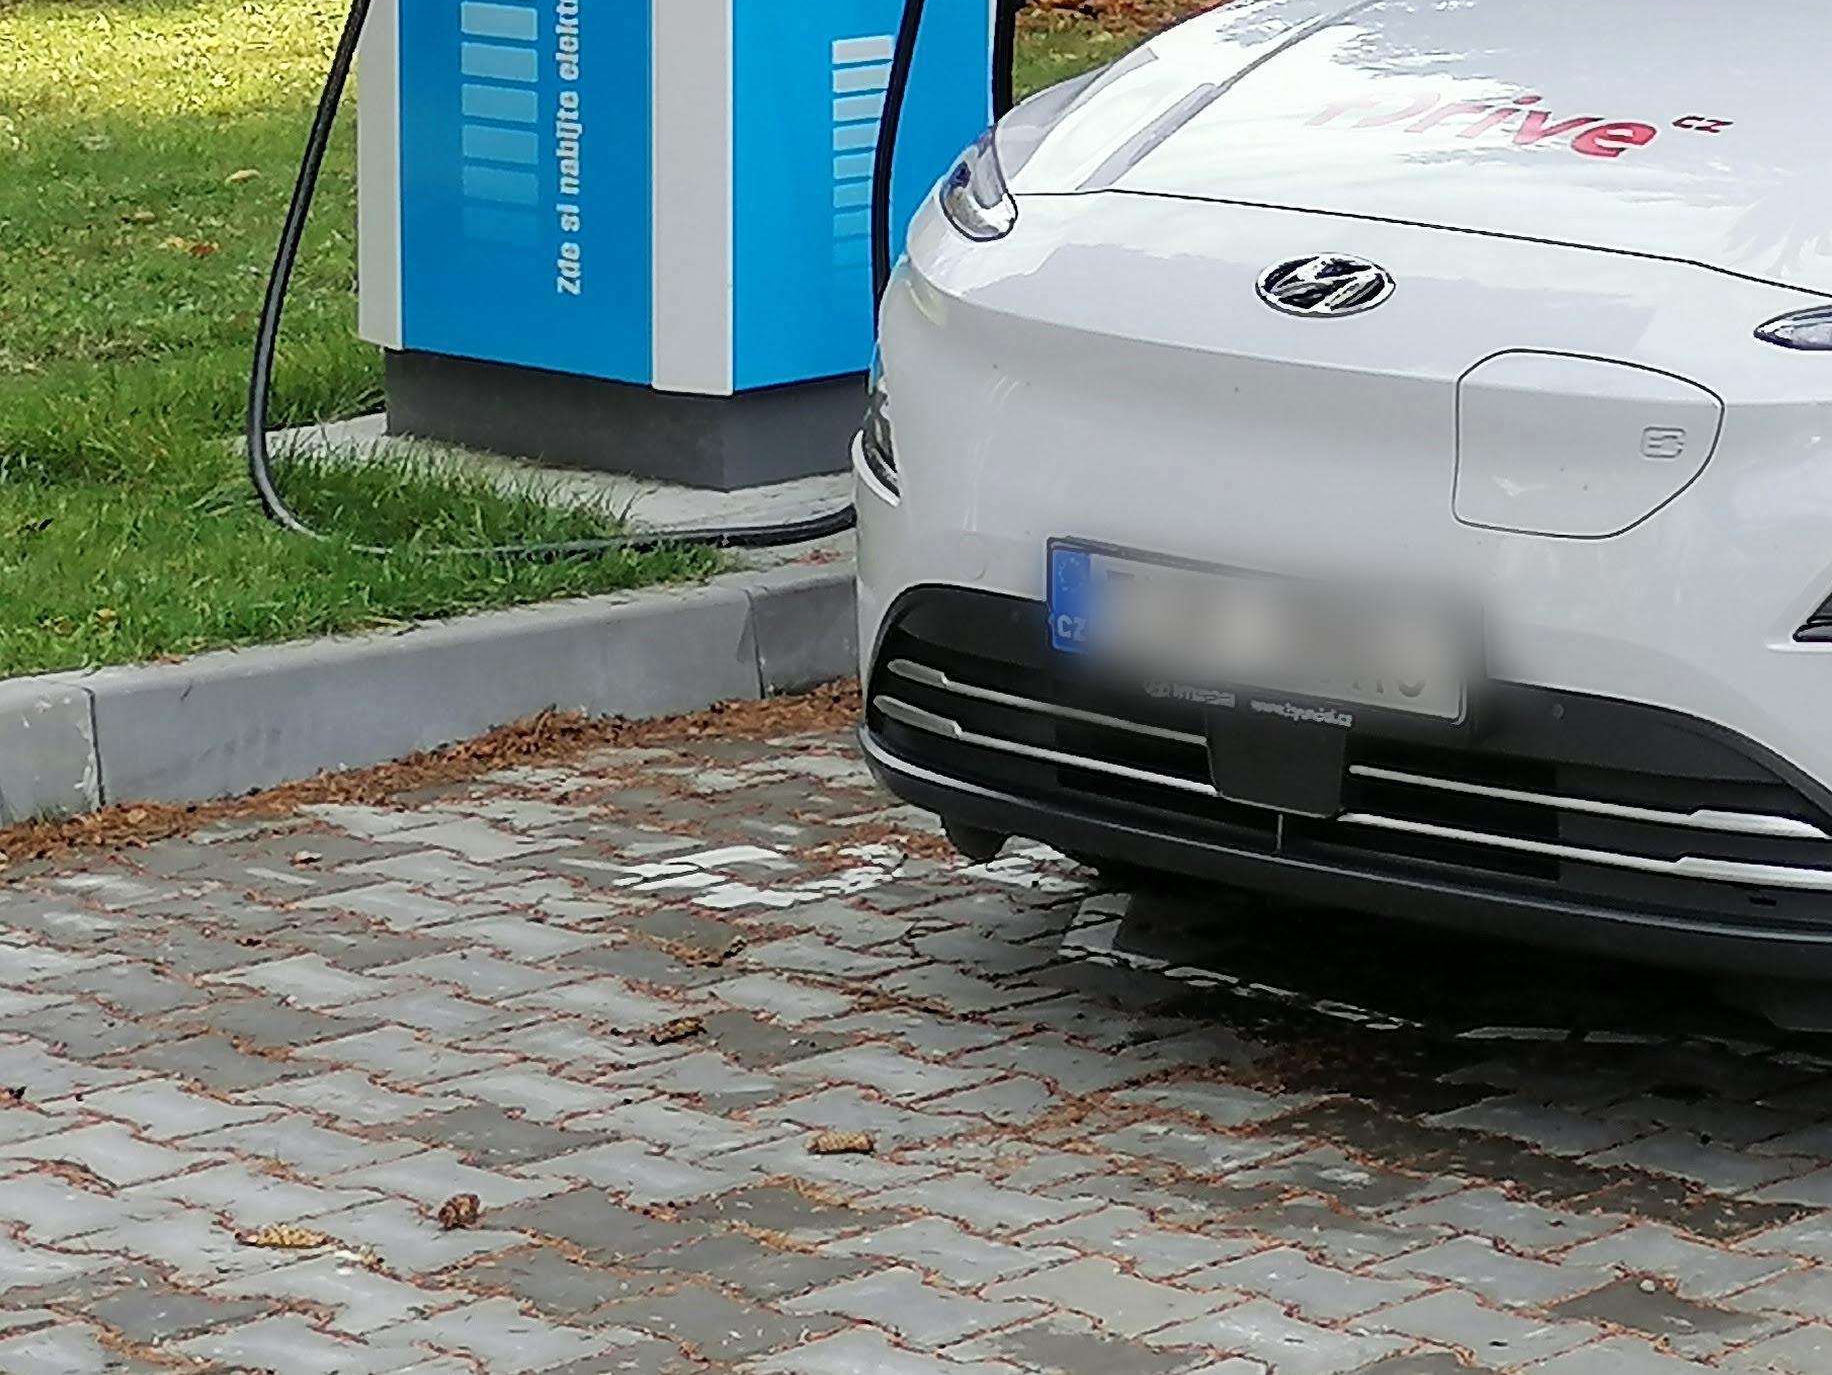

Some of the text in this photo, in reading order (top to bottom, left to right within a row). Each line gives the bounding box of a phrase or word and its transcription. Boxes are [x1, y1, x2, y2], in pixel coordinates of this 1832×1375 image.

[556, 203, 580, 232] si
[556, 241, 582, 296] Zde
[1057, 614, 1087, 641] CZ
